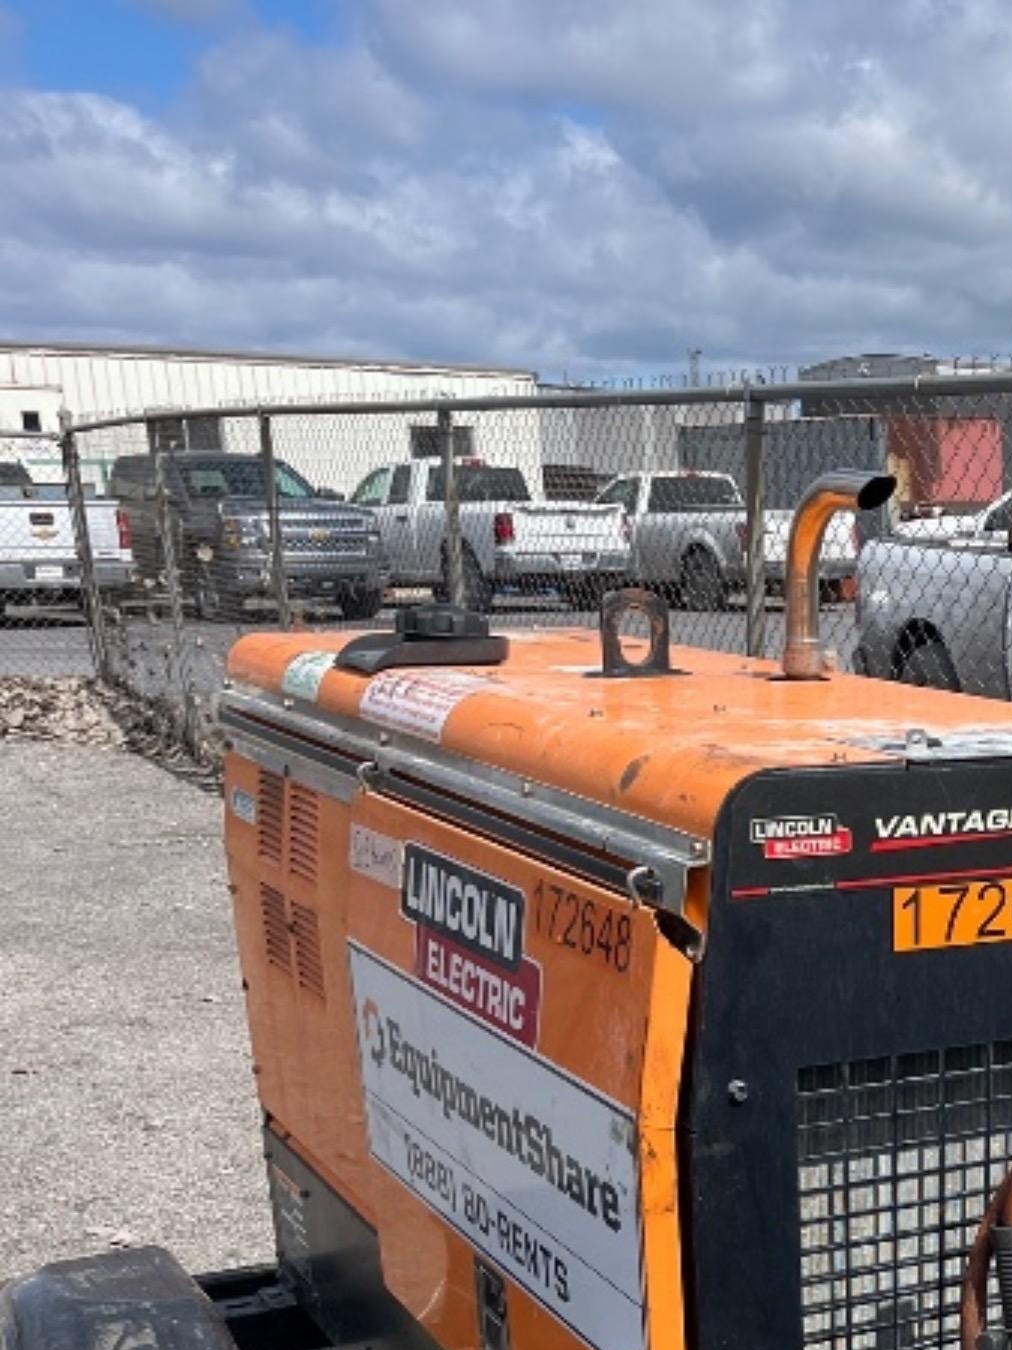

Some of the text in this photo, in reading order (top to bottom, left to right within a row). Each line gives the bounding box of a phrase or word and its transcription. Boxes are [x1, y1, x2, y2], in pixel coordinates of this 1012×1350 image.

[755, 818, 832, 839] LINCOLN
[407, 857, 517, 961] LINCOLN
[533, 879, 631, 972] 172648
[426, 939, 526, 1030] ELECTRIC
[386, 1017, 622, 1234] EquipmentShare
[462, 1183, 571, 1303] 80-RENTS
